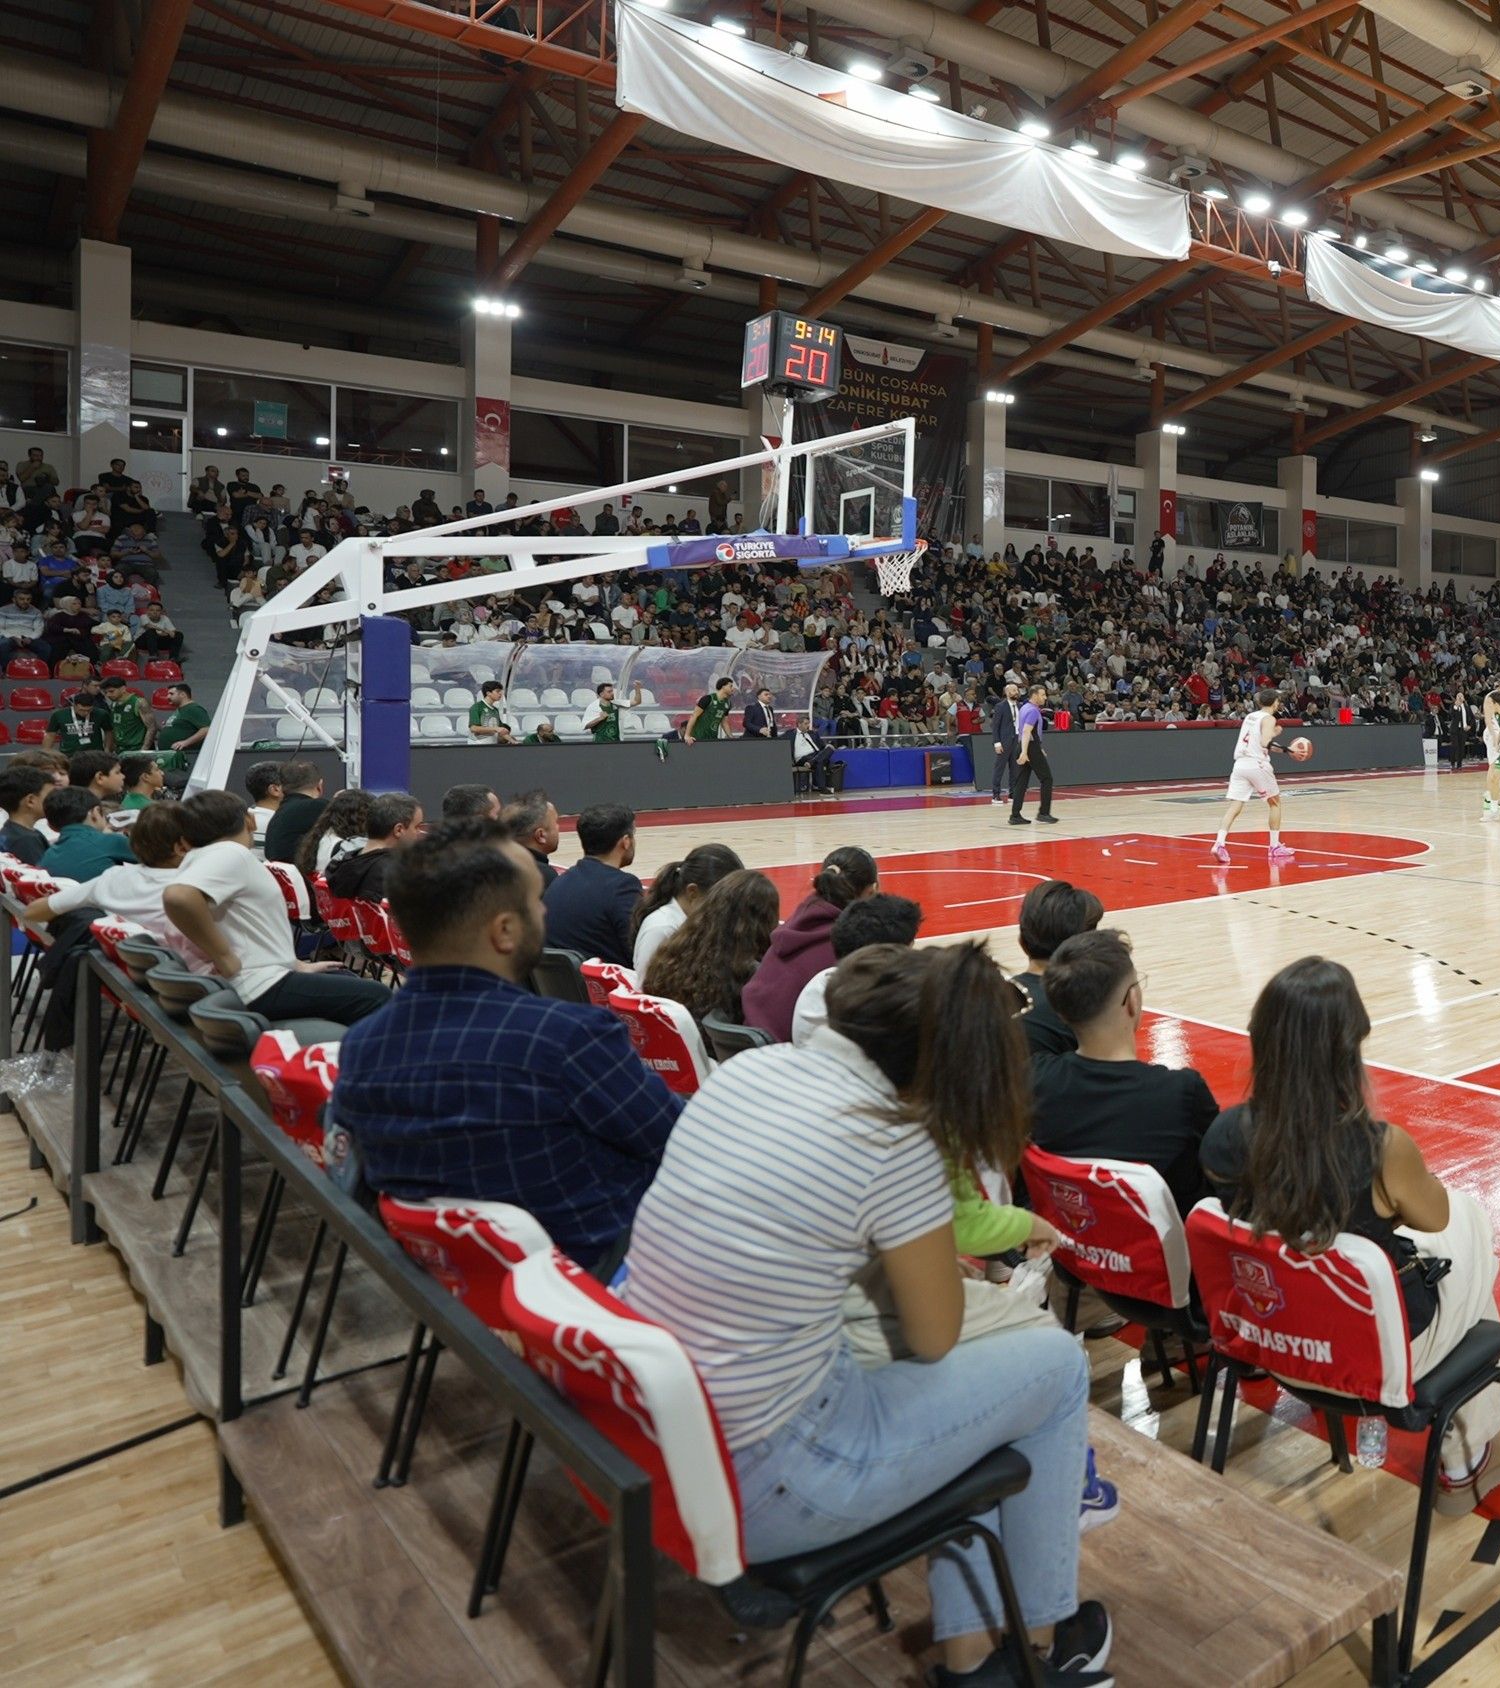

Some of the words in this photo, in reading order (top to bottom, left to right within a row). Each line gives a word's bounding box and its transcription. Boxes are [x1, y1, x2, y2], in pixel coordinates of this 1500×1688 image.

[795, 321, 835, 346] 9:14
[786, 345, 828, 384] 20
[838, 384, 929, 409] ONİKİŞUBAT
[880, 372, 947, 398] COŞARSA
[827, 399, 884, 418] ZAFERE
[871, 442, 894, 452] SPOR
